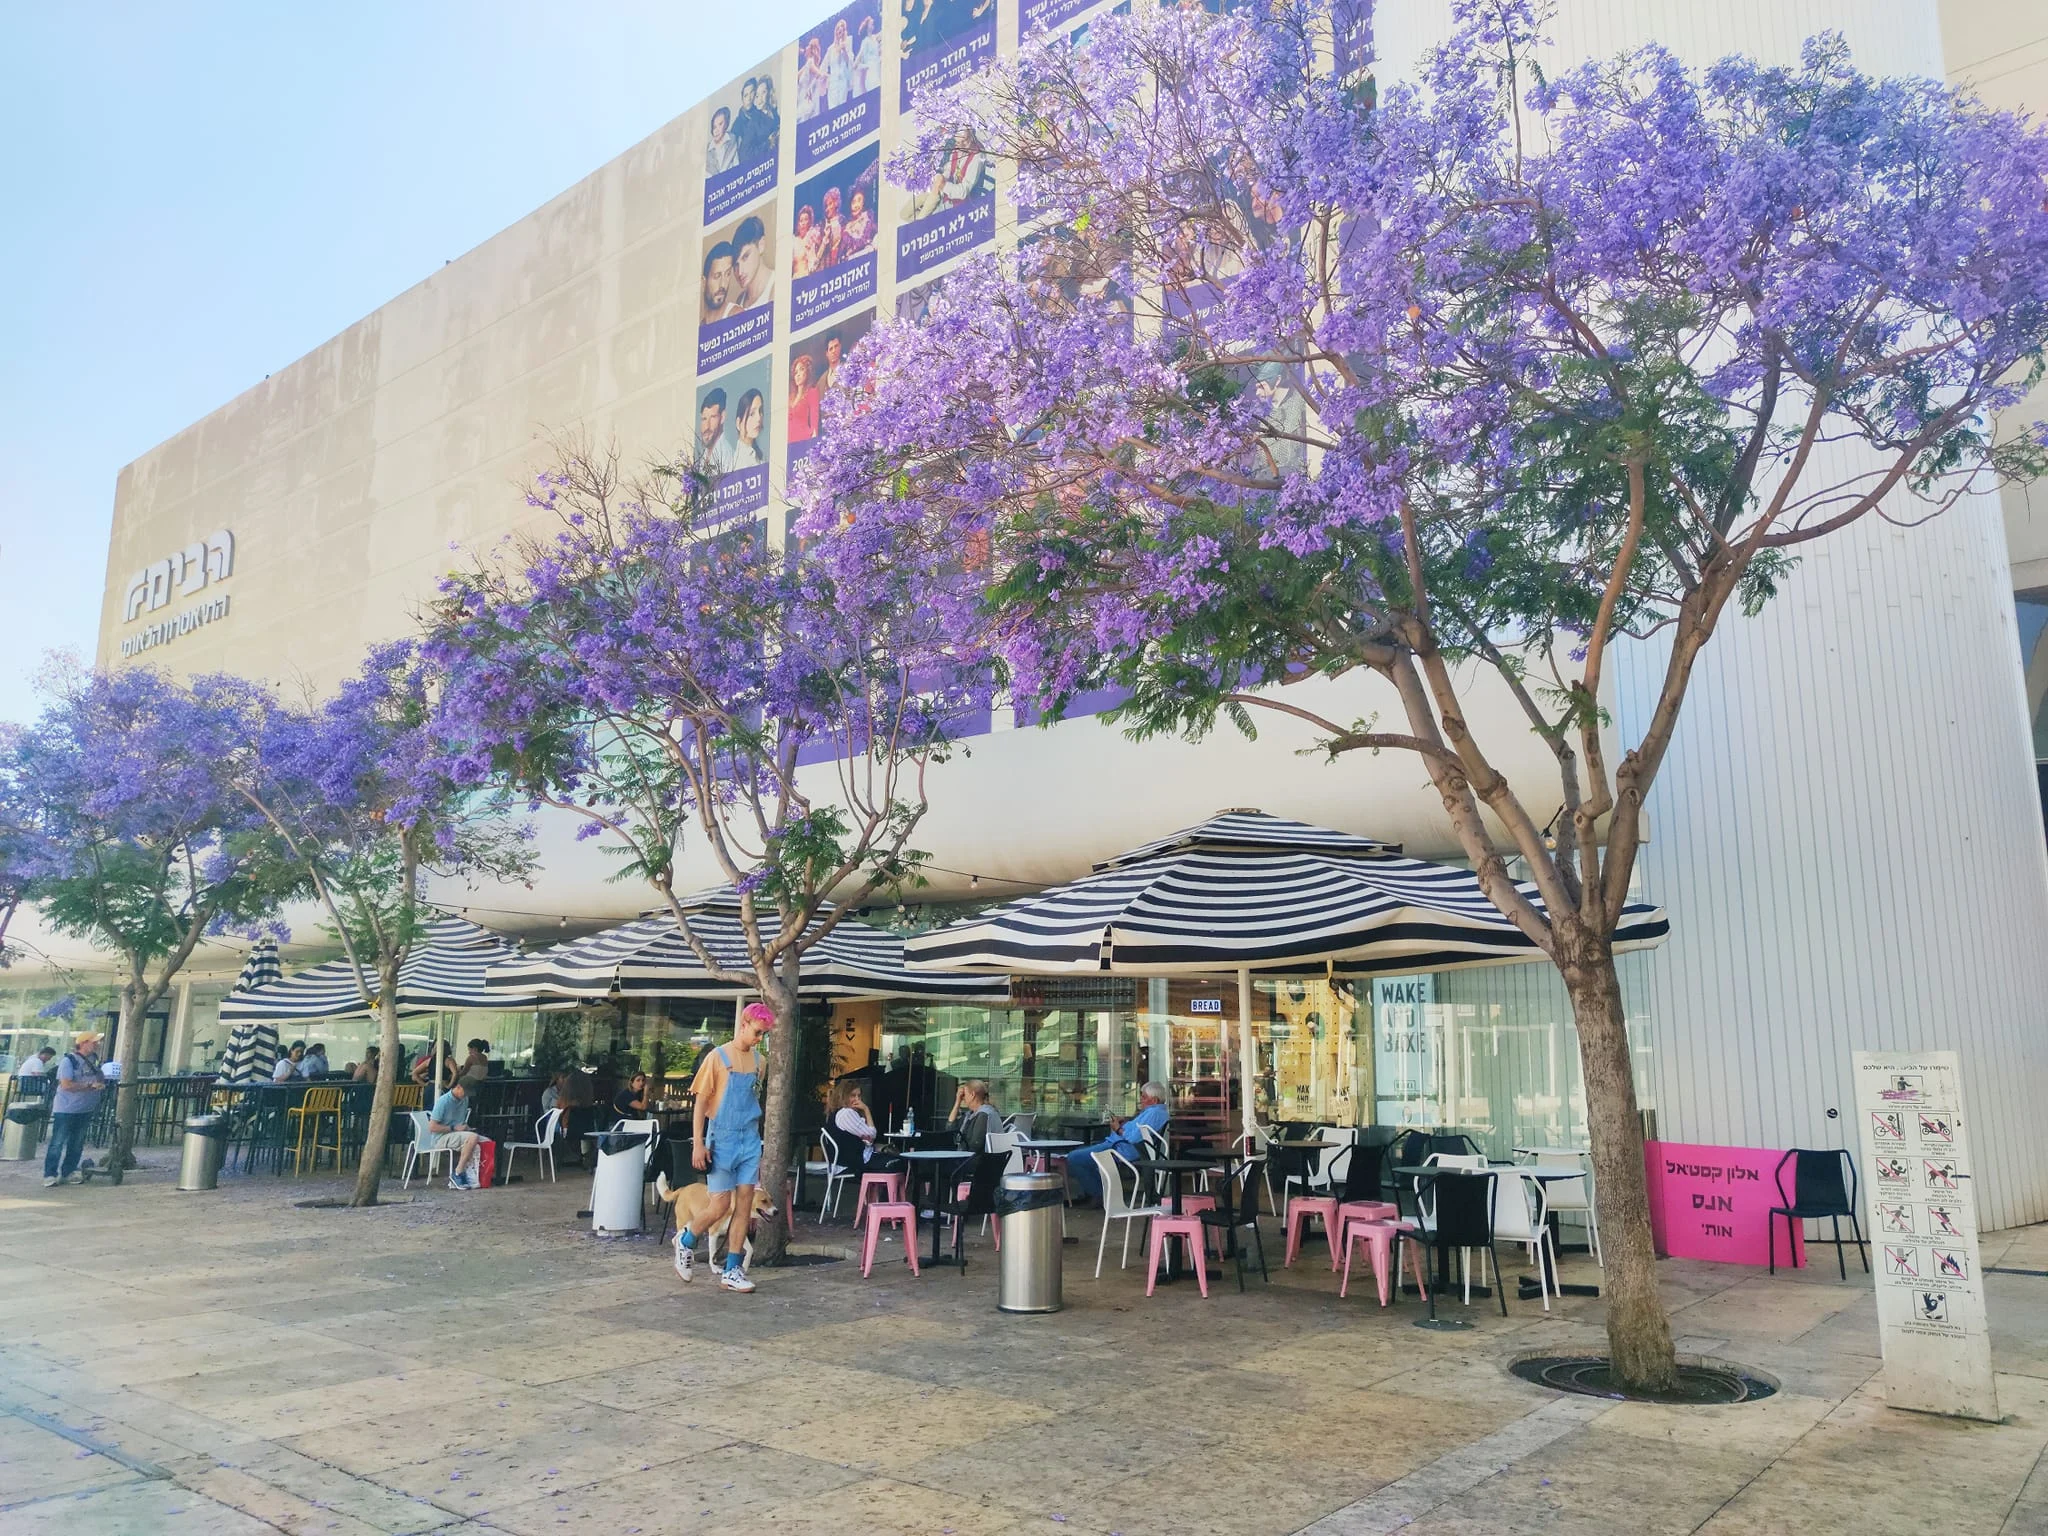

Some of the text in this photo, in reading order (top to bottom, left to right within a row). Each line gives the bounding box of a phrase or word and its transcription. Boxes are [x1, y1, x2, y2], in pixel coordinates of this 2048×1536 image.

[905, 32, 990, 92] עוד חוזר הניגון
[808, 102, 866, 146] מאמא מיה
[812, 123, 862, 156] מחזמר בינלאומי
[726, 176, 744, 192] סיפור
[755, 175, 772, 190] דרמה
[708, 187, 725, 204] אהבה
[731, 184, 755, 205] ישראלית
[901, 204, 989, 257] אני לא רפפורט
[919, 231, 974, 264] קומדיה מרגשת
[796, 261, 871, 306] זאקופנה שלי
[847, 280, 871, 298] קומדיה
[795, 307, 814, 322] עליכם
[815, 299, 831, 313] שלום
[699, 310, 770, 353] את שאהבה נפשי
[700, 329, 769, 367] דרמה משפחתית מקורית
[122, 529, 235, 624] הבימה
[1381, 982, 1427, 1003] WAKE
[1192, 1000, 1219, 1011] BREAD
[1863, 1063, 1882, 1071] שלכם
[1666, 1159, 1759, 1184] אלון קסטיאל
[1692, 1193, 1734, 1212] אנס
[1701, 1223, 1733, 1238] אותי
